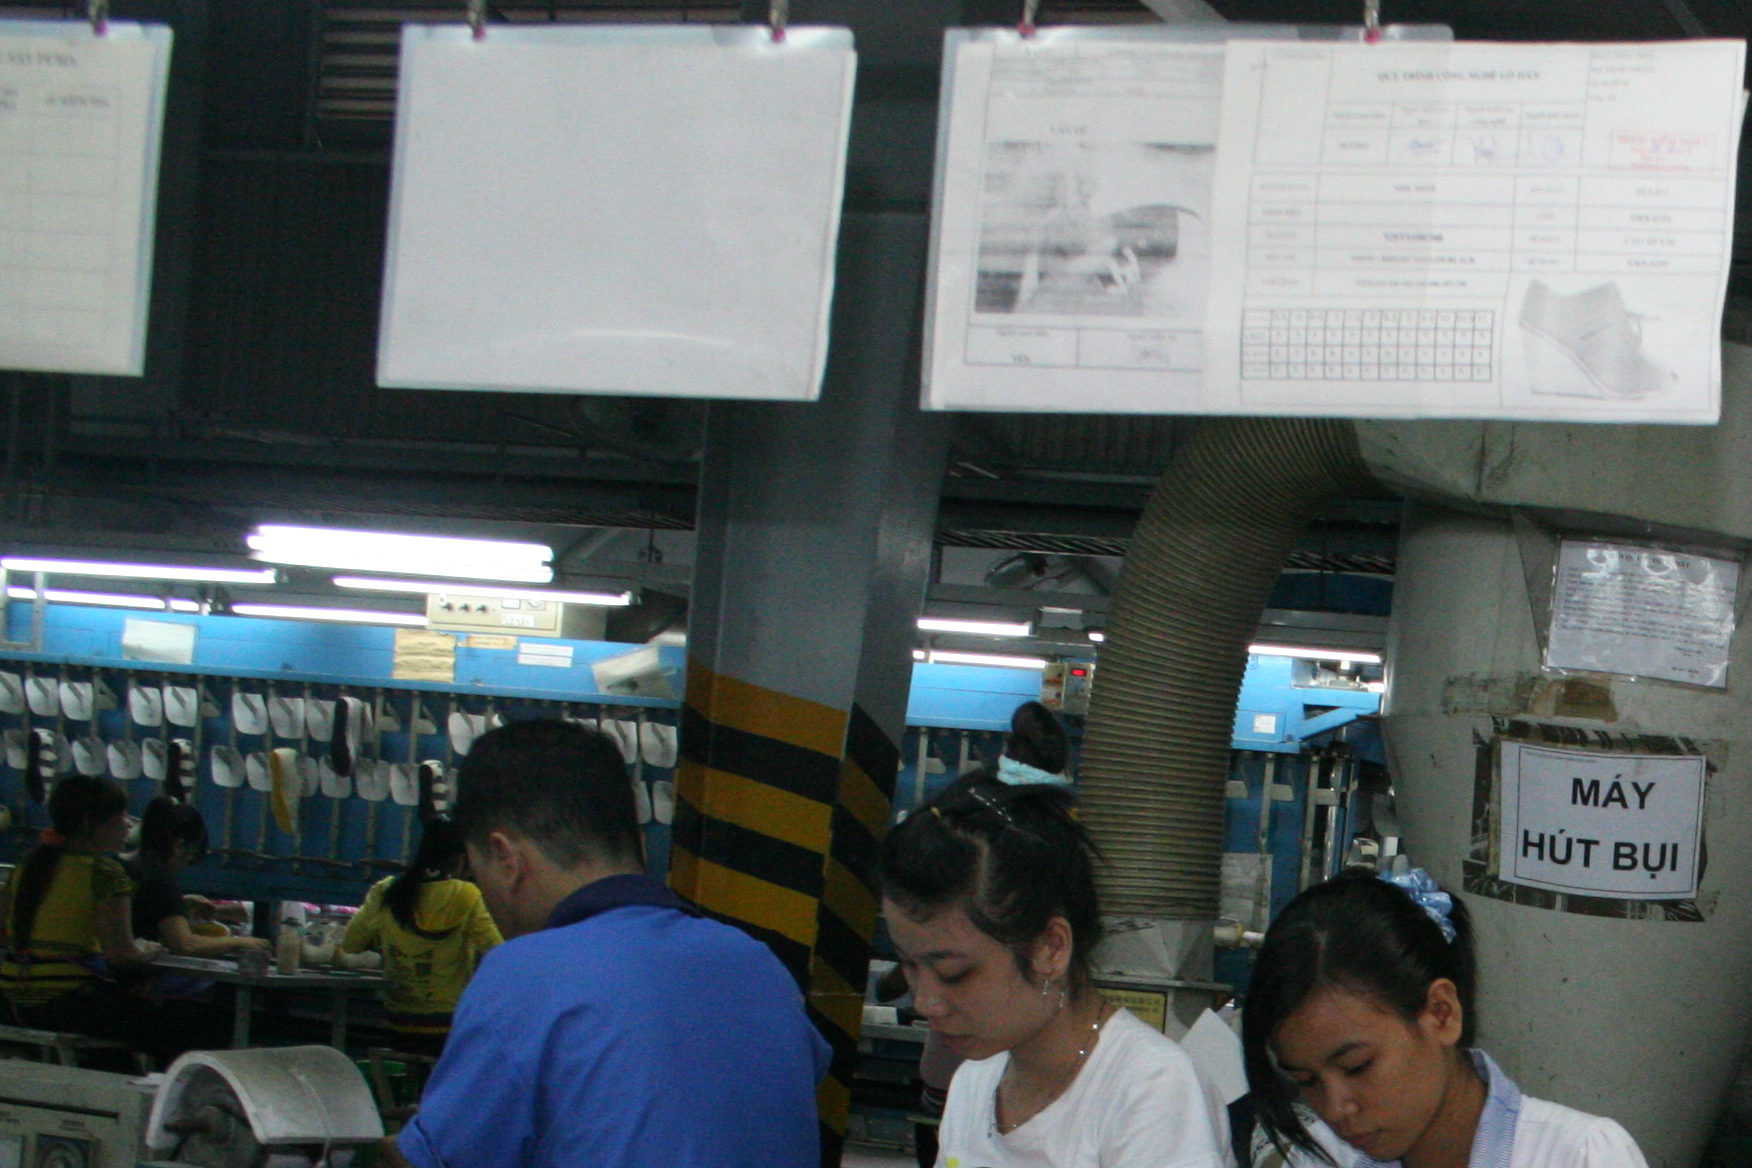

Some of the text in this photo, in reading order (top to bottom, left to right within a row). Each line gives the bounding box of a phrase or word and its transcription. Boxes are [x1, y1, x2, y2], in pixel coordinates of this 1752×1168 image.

[1570, 774, 1656, 810] MÁY
[1521, 828, 1679, 880] HÚT BỤI
